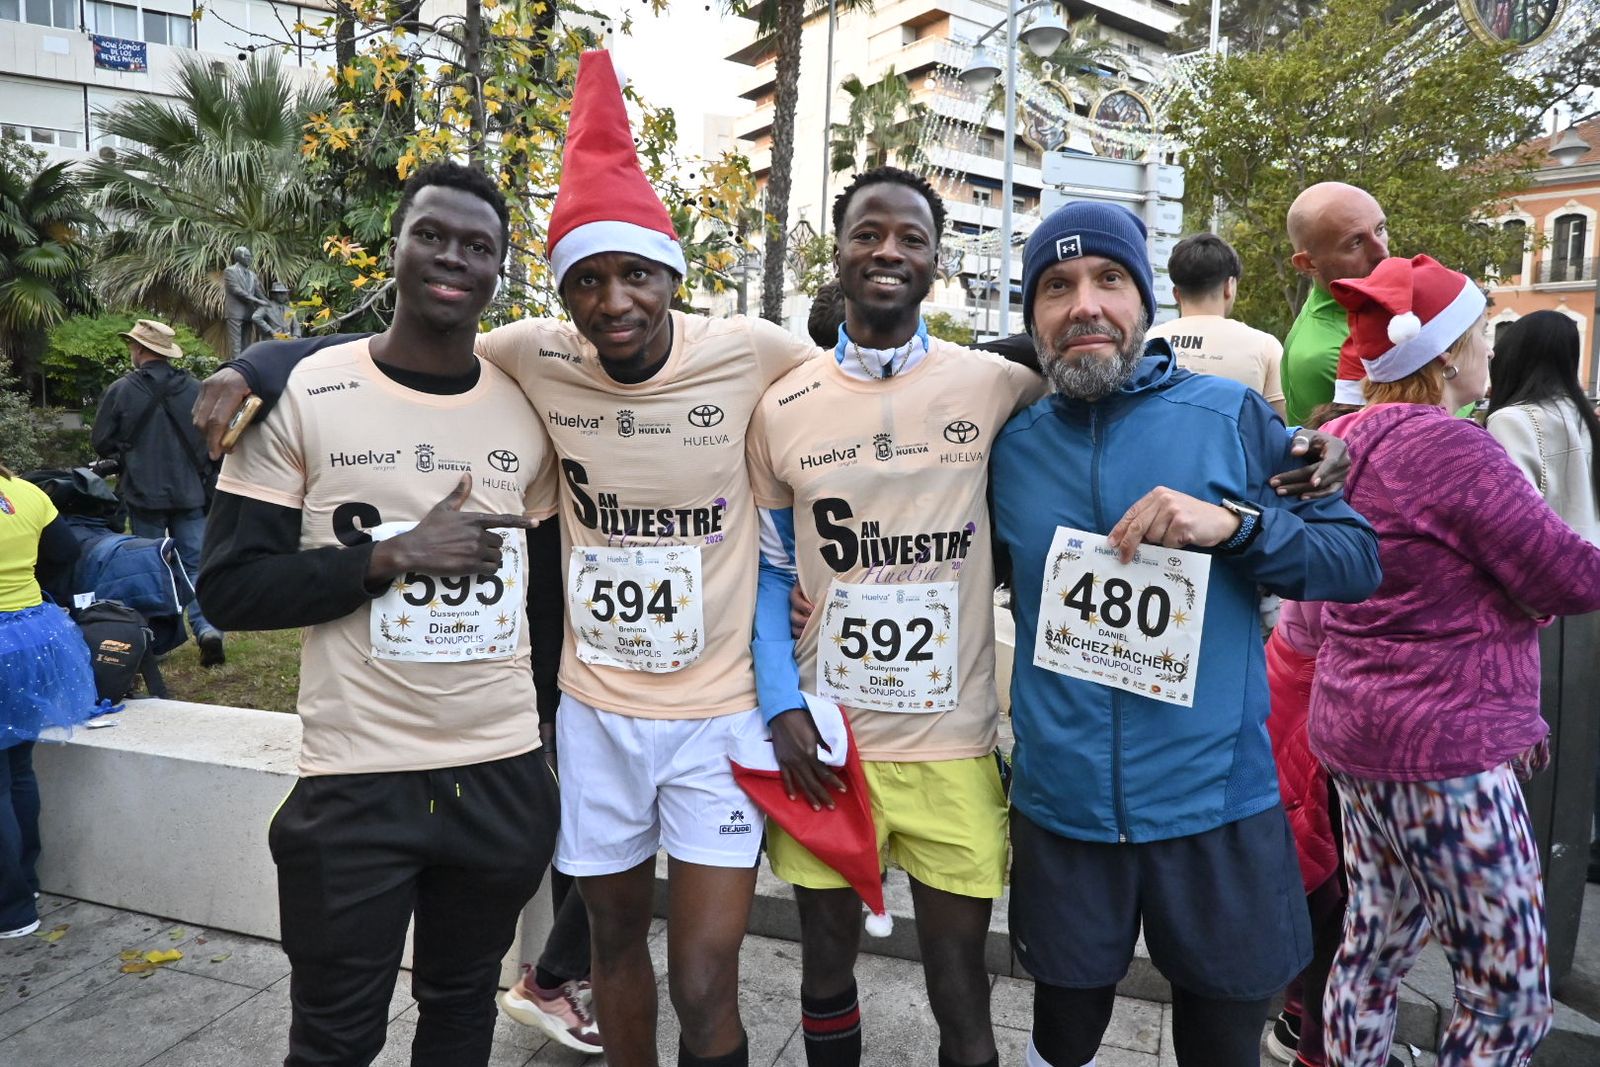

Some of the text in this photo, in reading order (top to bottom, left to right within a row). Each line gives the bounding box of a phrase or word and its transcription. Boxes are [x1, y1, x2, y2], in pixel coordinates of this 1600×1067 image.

[1170, 335, 1203, 349] RUN
[538, 348, 570, 361] luanvi
[307, 382, 346, 396] luanvi
[778, 387, 810, 406] luanvi
[549, 411, 599, 429] Huelva
[638, 427, 671, 435] HUELVA
[683, 434, 730, 446] HUELVA
[896, 446, 929, 456] HUELVA
[330, 449, 396, 468] Huelva
[800, 446, 857, 470] Huelva
[940, 452, 983, 463] HUELVA
[438, 464, 472, 472] HUELVA
[704, 534, 723, 545] 2025
[402, 561, 504, 606] 595
[591, 579, 678, 623] 594
[1063, 572, 1171, 638] 480
[430, 609, 480, 619] Ousseynouh
[429, 622, 480, 634] Diadhar
[618, 625, 647, 633] Brehima
[434, 634, 484, 645] ONUPOLIS
[840, 617, 934, 662] 592
[1098, 628, 1129, 643] DANIEL
[621, 647, 662, 658] ONUPOLIS
[1045, 630, 1109, 656] SANCHEZ
[1113, 647, 1185, 675] HACHERO
[864, 663, 910, 673] Souleymane
[1091, 655, 1143, 676] ONUPOLIS
[869, 675, 904, 687] Diallo
[869, 687, 917, 698] ONUPOLIS
